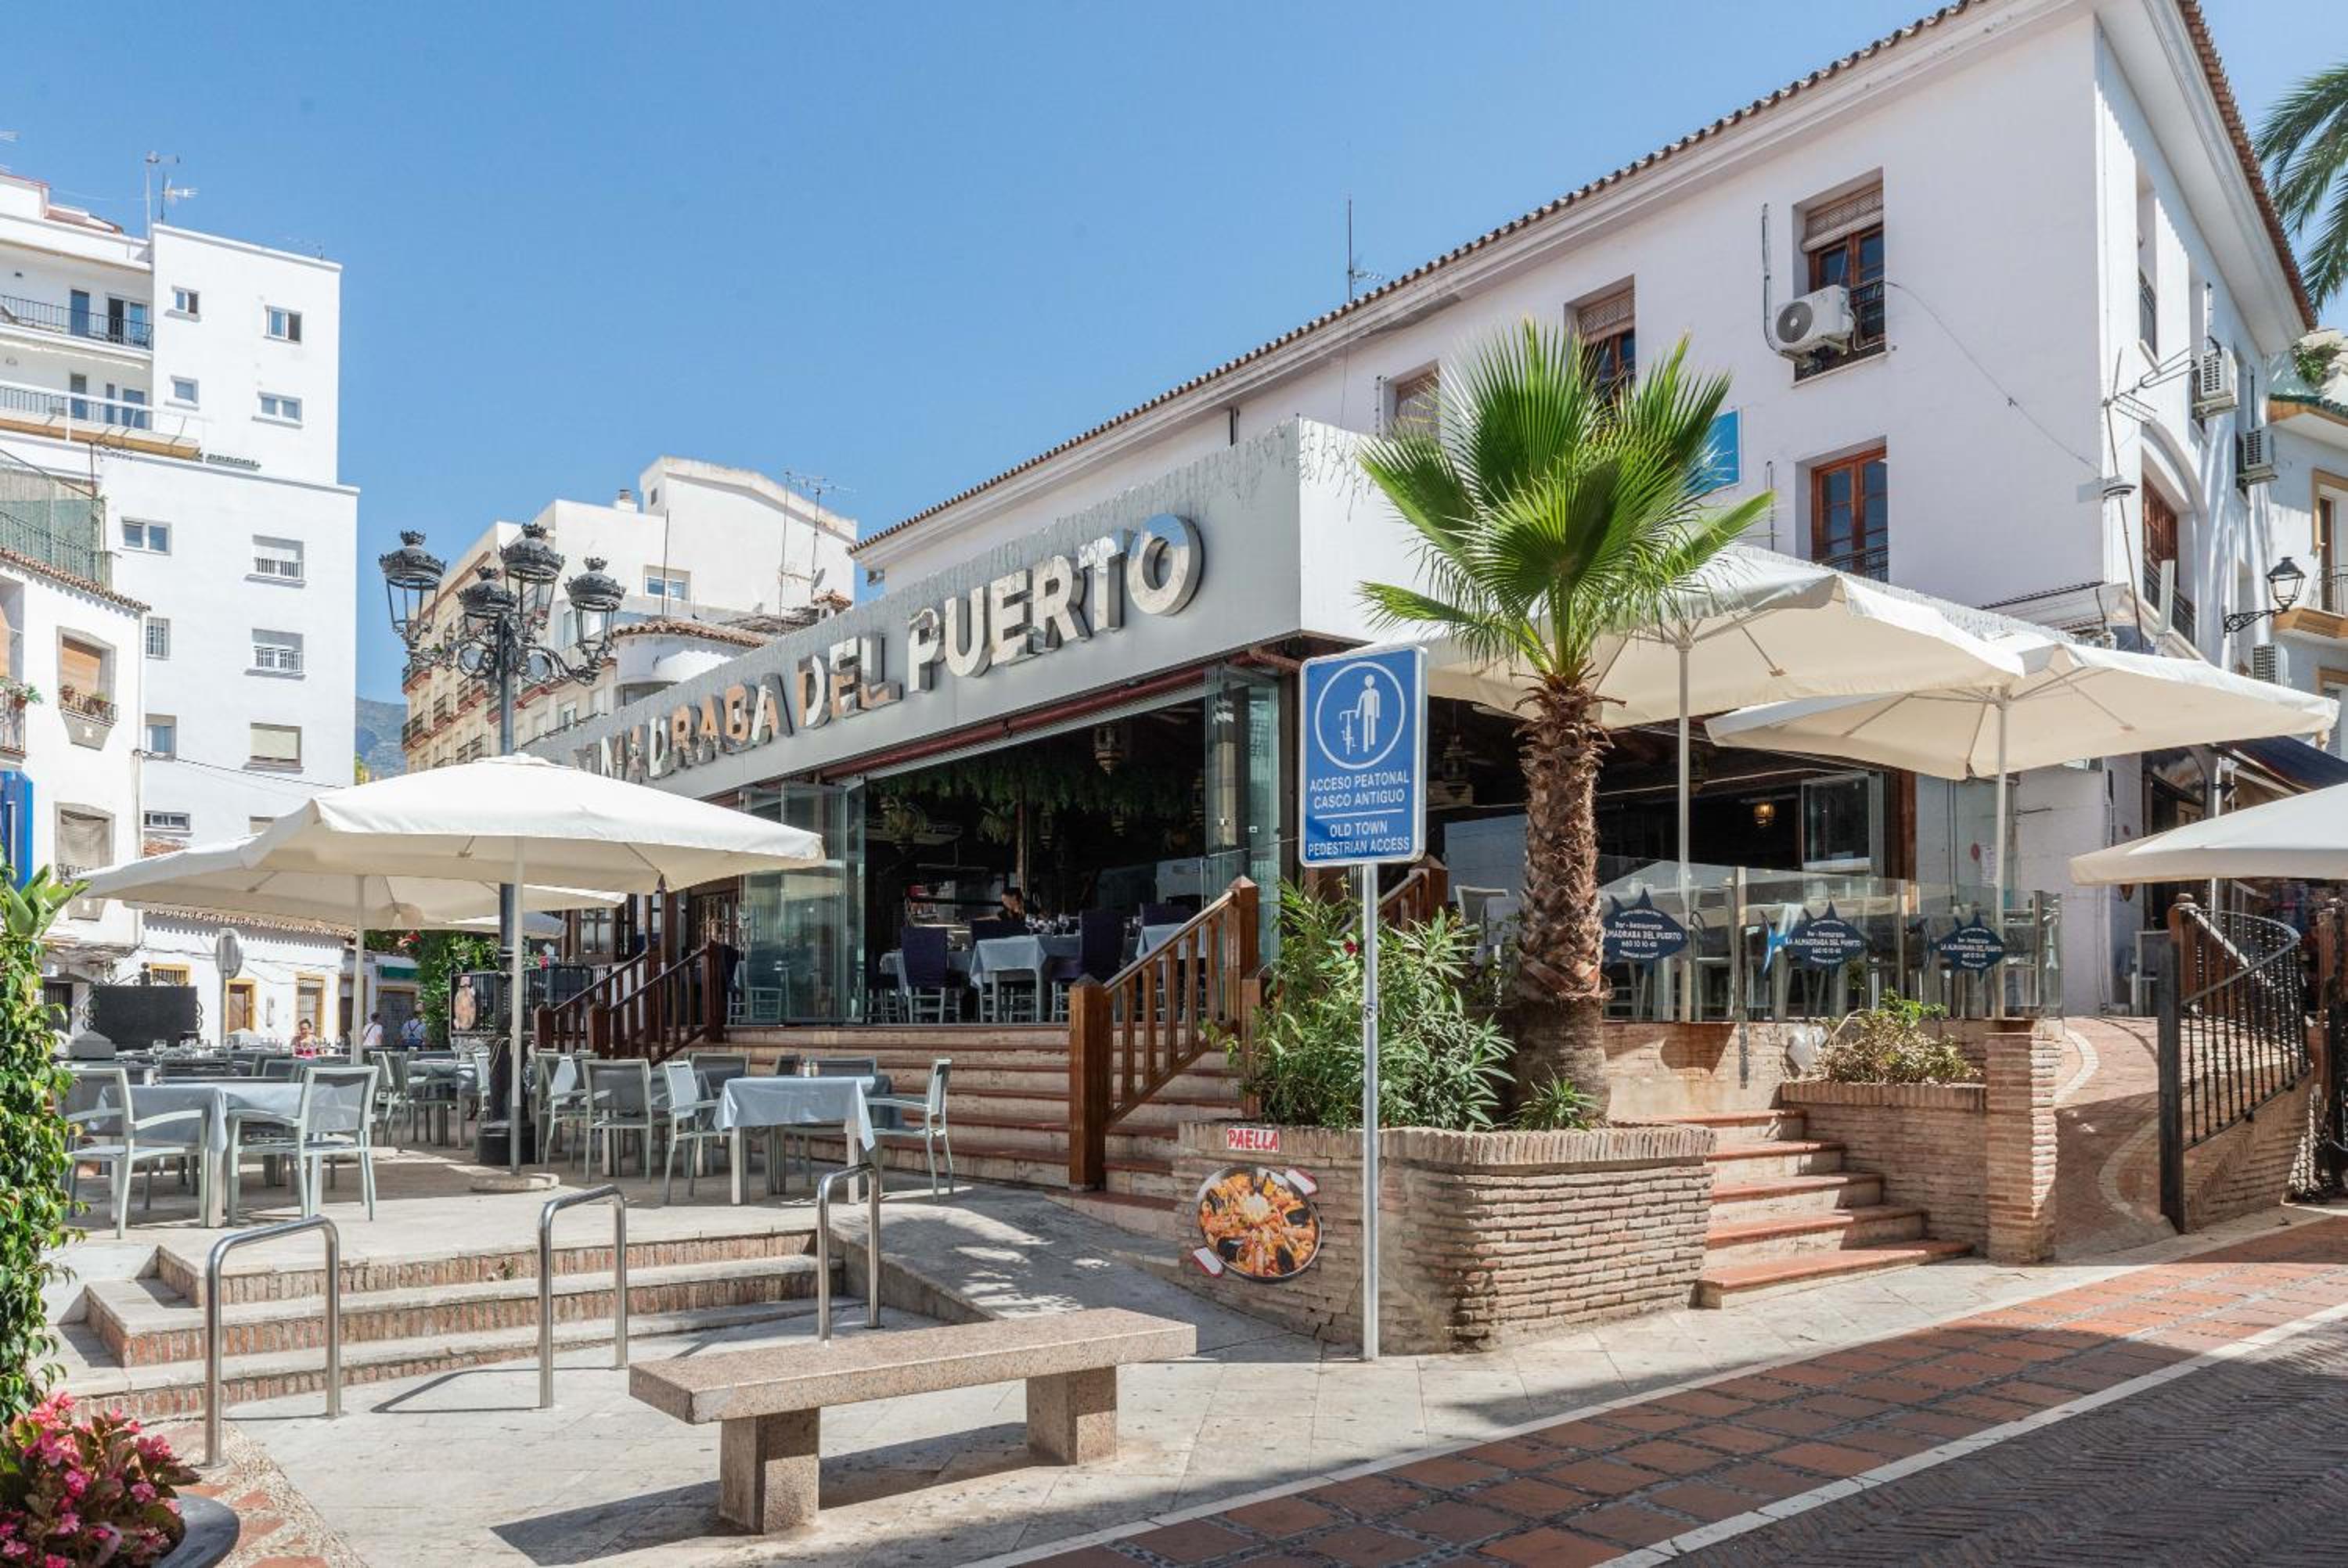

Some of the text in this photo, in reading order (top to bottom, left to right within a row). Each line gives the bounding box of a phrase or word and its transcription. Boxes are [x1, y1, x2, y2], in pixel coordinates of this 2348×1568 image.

[575, 512, 1203, 785] MADRABA DEL PUERTO
[1309, 770, 1410, 792] ACCESO PEATONAL
[1314, 789, 1405, 809] CASCO ANTIGUO
[1330, 820, 1388, 837] OLD TOWN
[1308, 836, 1410, 856] PEDESTRIAN ACCESS
[1227, 1129, 1279, 1150] PAELLA
